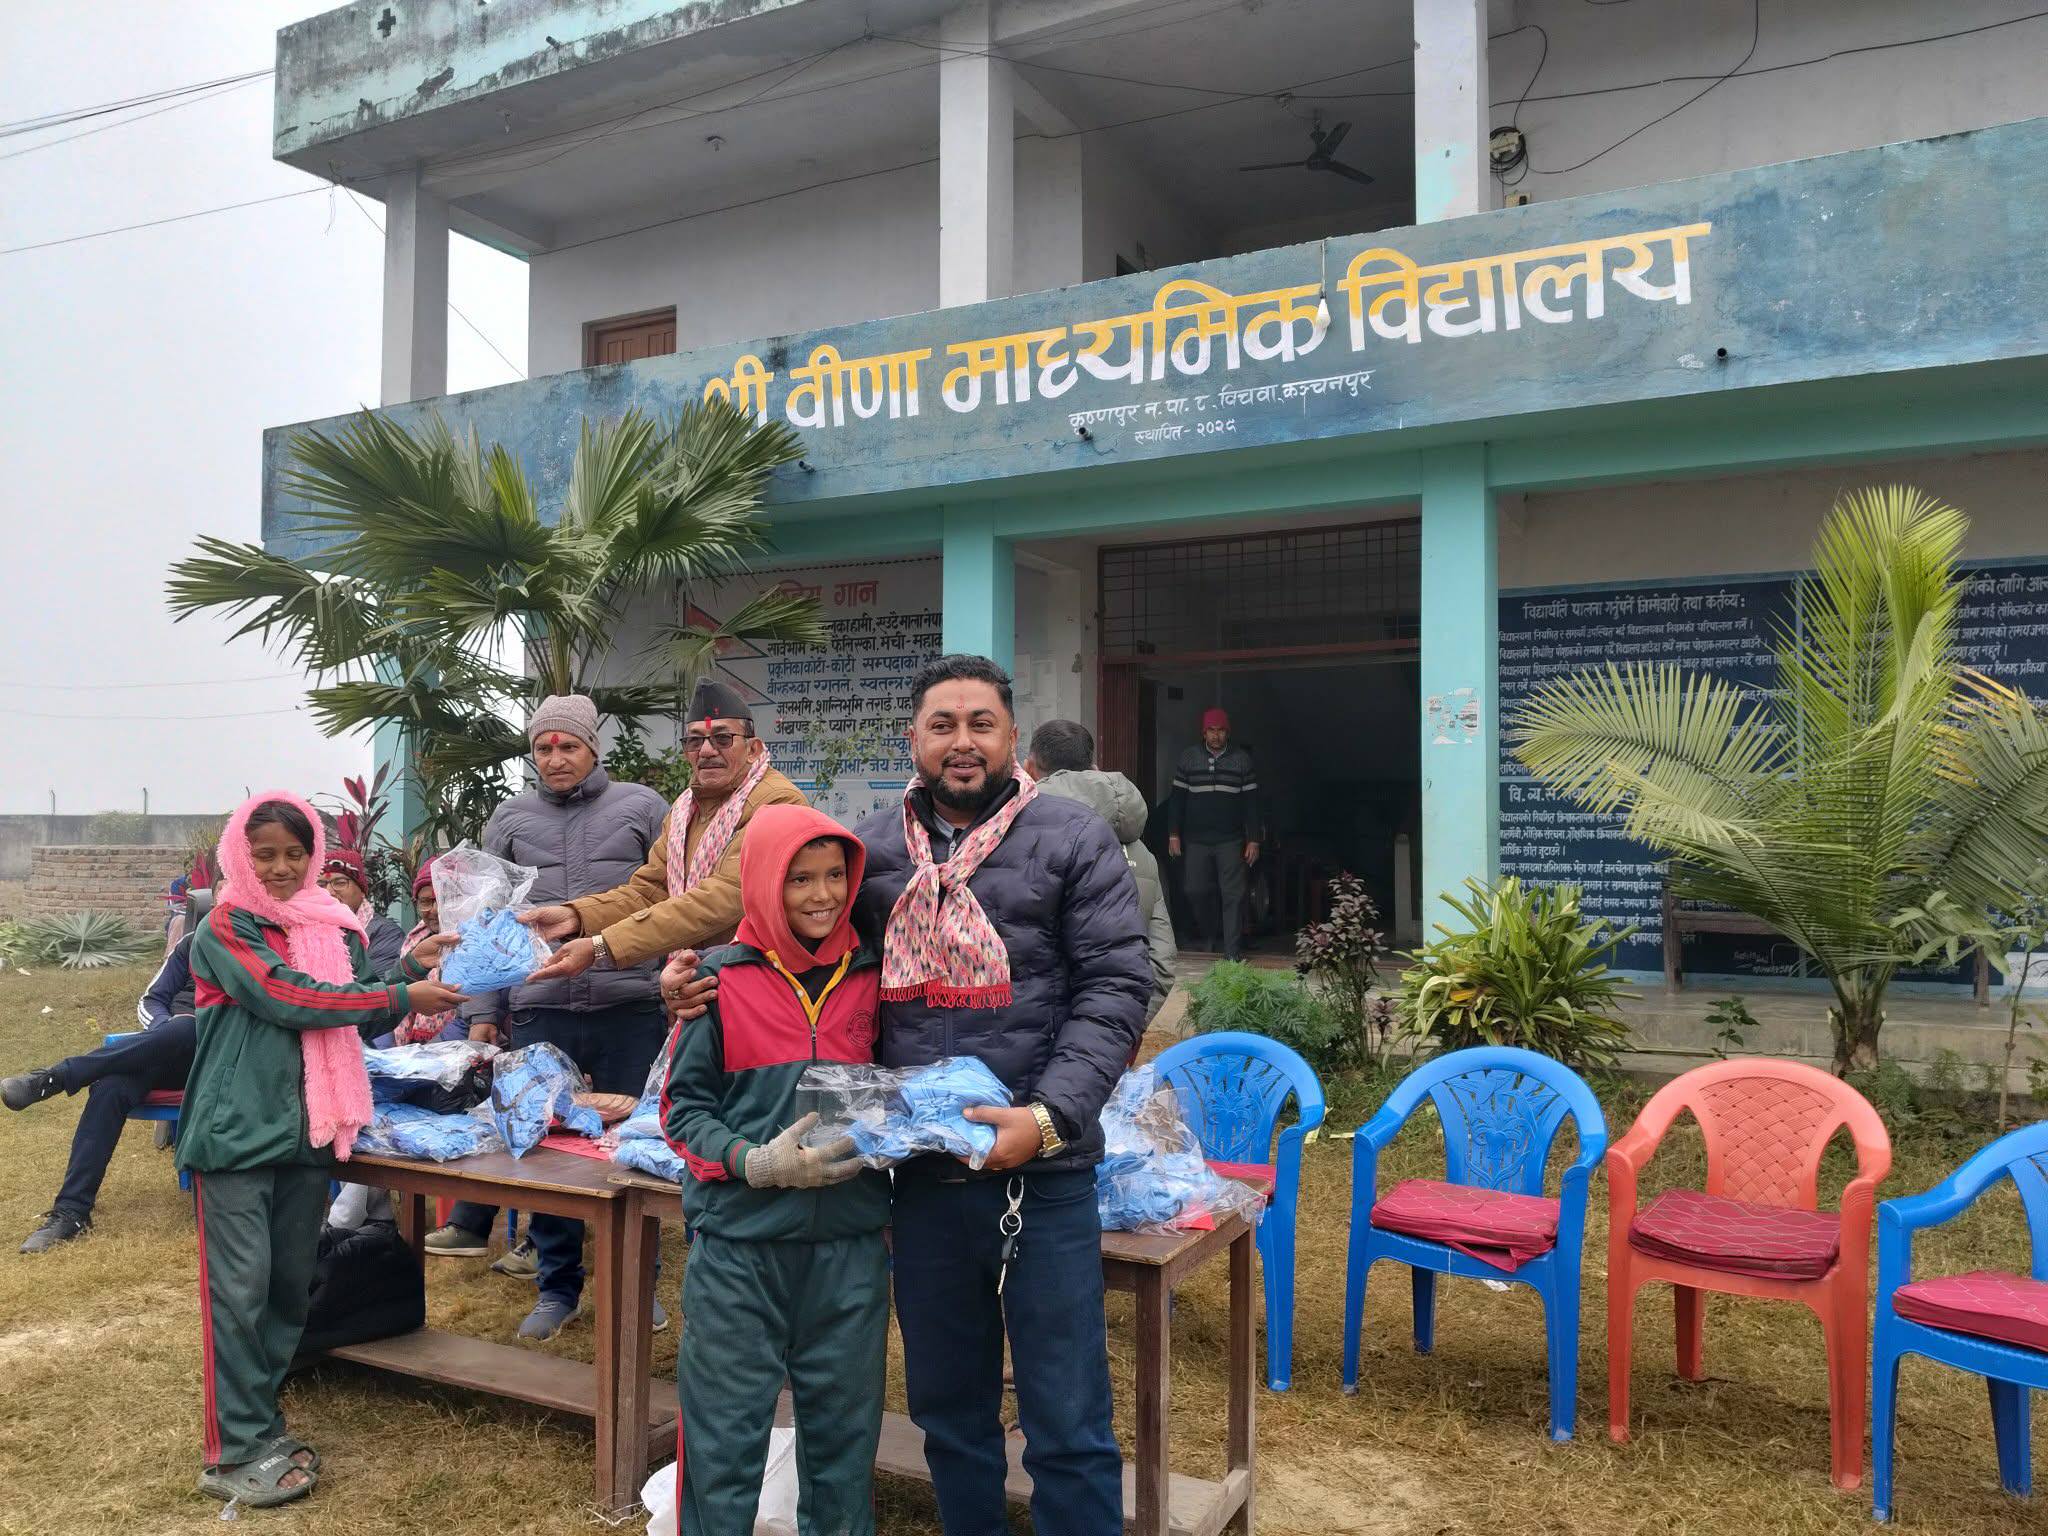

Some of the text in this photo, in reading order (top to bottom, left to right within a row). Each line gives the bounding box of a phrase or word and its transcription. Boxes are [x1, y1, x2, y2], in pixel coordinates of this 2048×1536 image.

[786, 344, 932, 429] वीणा
[1336, 222, 1712, 351] विद्यालय
[833, 580, 880, 608] गान
[869, 757, 889, 772] जय
